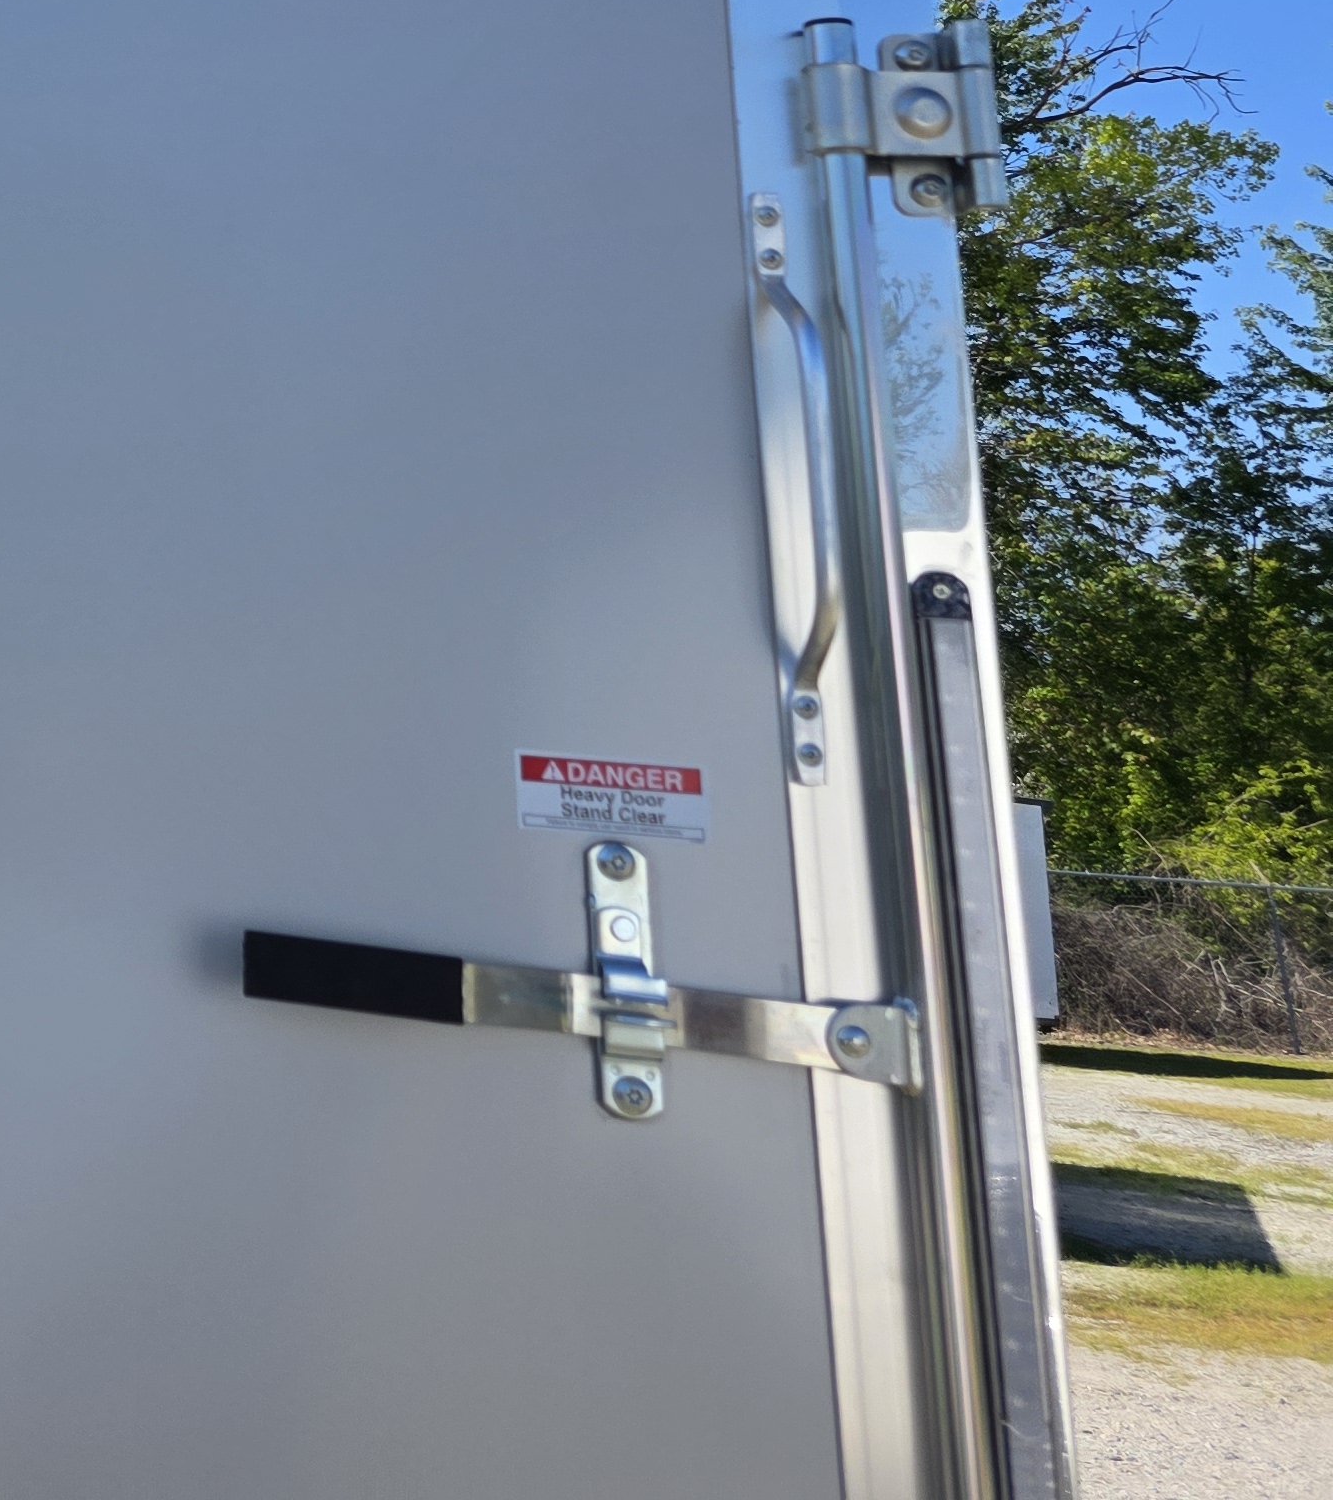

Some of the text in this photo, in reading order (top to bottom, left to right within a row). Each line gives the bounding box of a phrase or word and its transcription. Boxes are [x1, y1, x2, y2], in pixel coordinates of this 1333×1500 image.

[566, 761, 683, 791] DANGER
[560, 785, 665, 807] Heavy Door
[561, 802, 666, 825] Stand Clear
